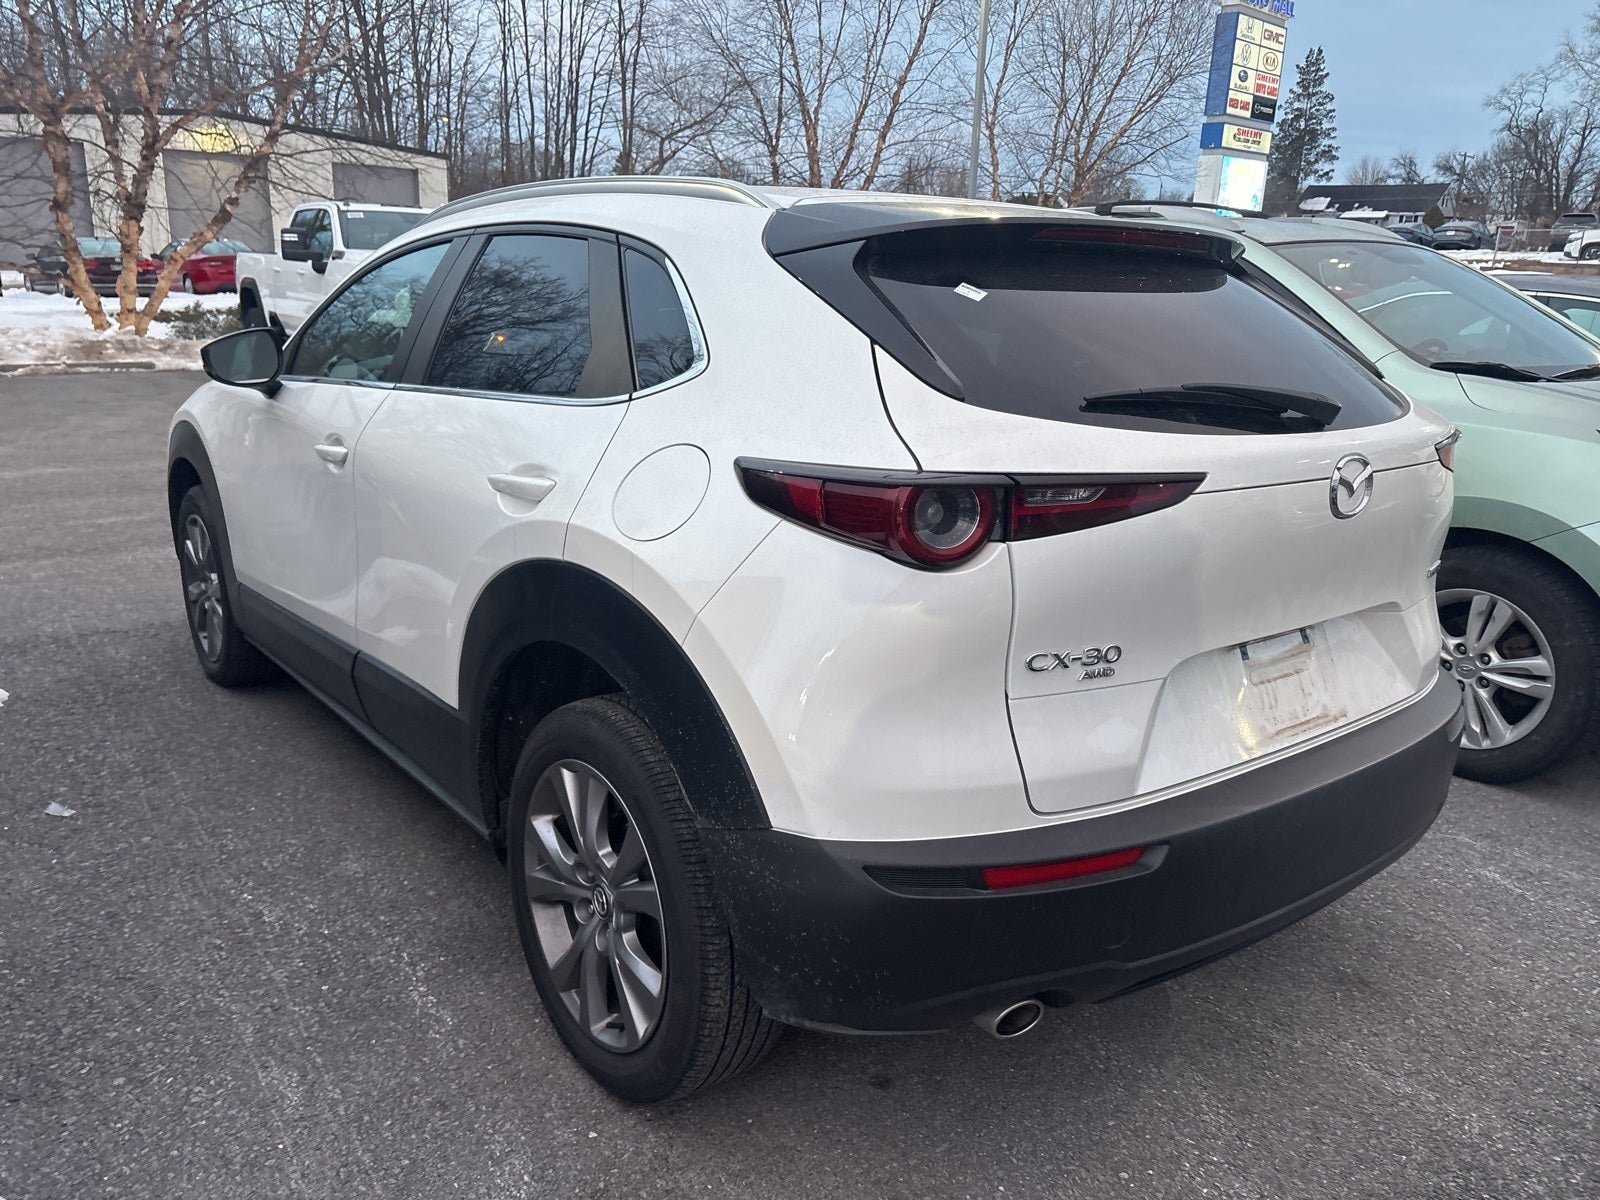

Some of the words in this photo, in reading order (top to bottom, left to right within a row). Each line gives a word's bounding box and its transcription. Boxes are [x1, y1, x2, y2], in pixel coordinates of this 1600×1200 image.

[1263, 29, 1284, 45] GMC
[1265, 56, 1276, 68] KIA
[1256, 73, 1278, 84] SHEEHY
[1229, 98, 1239, 109] USED
[1240, 100, 1250, 111] CARS
[1237, 128, 1262, 139] SHEEHY
[1024, 644, 1122, 672] CX-30
[1078, 667, 1115, 681] AWD
